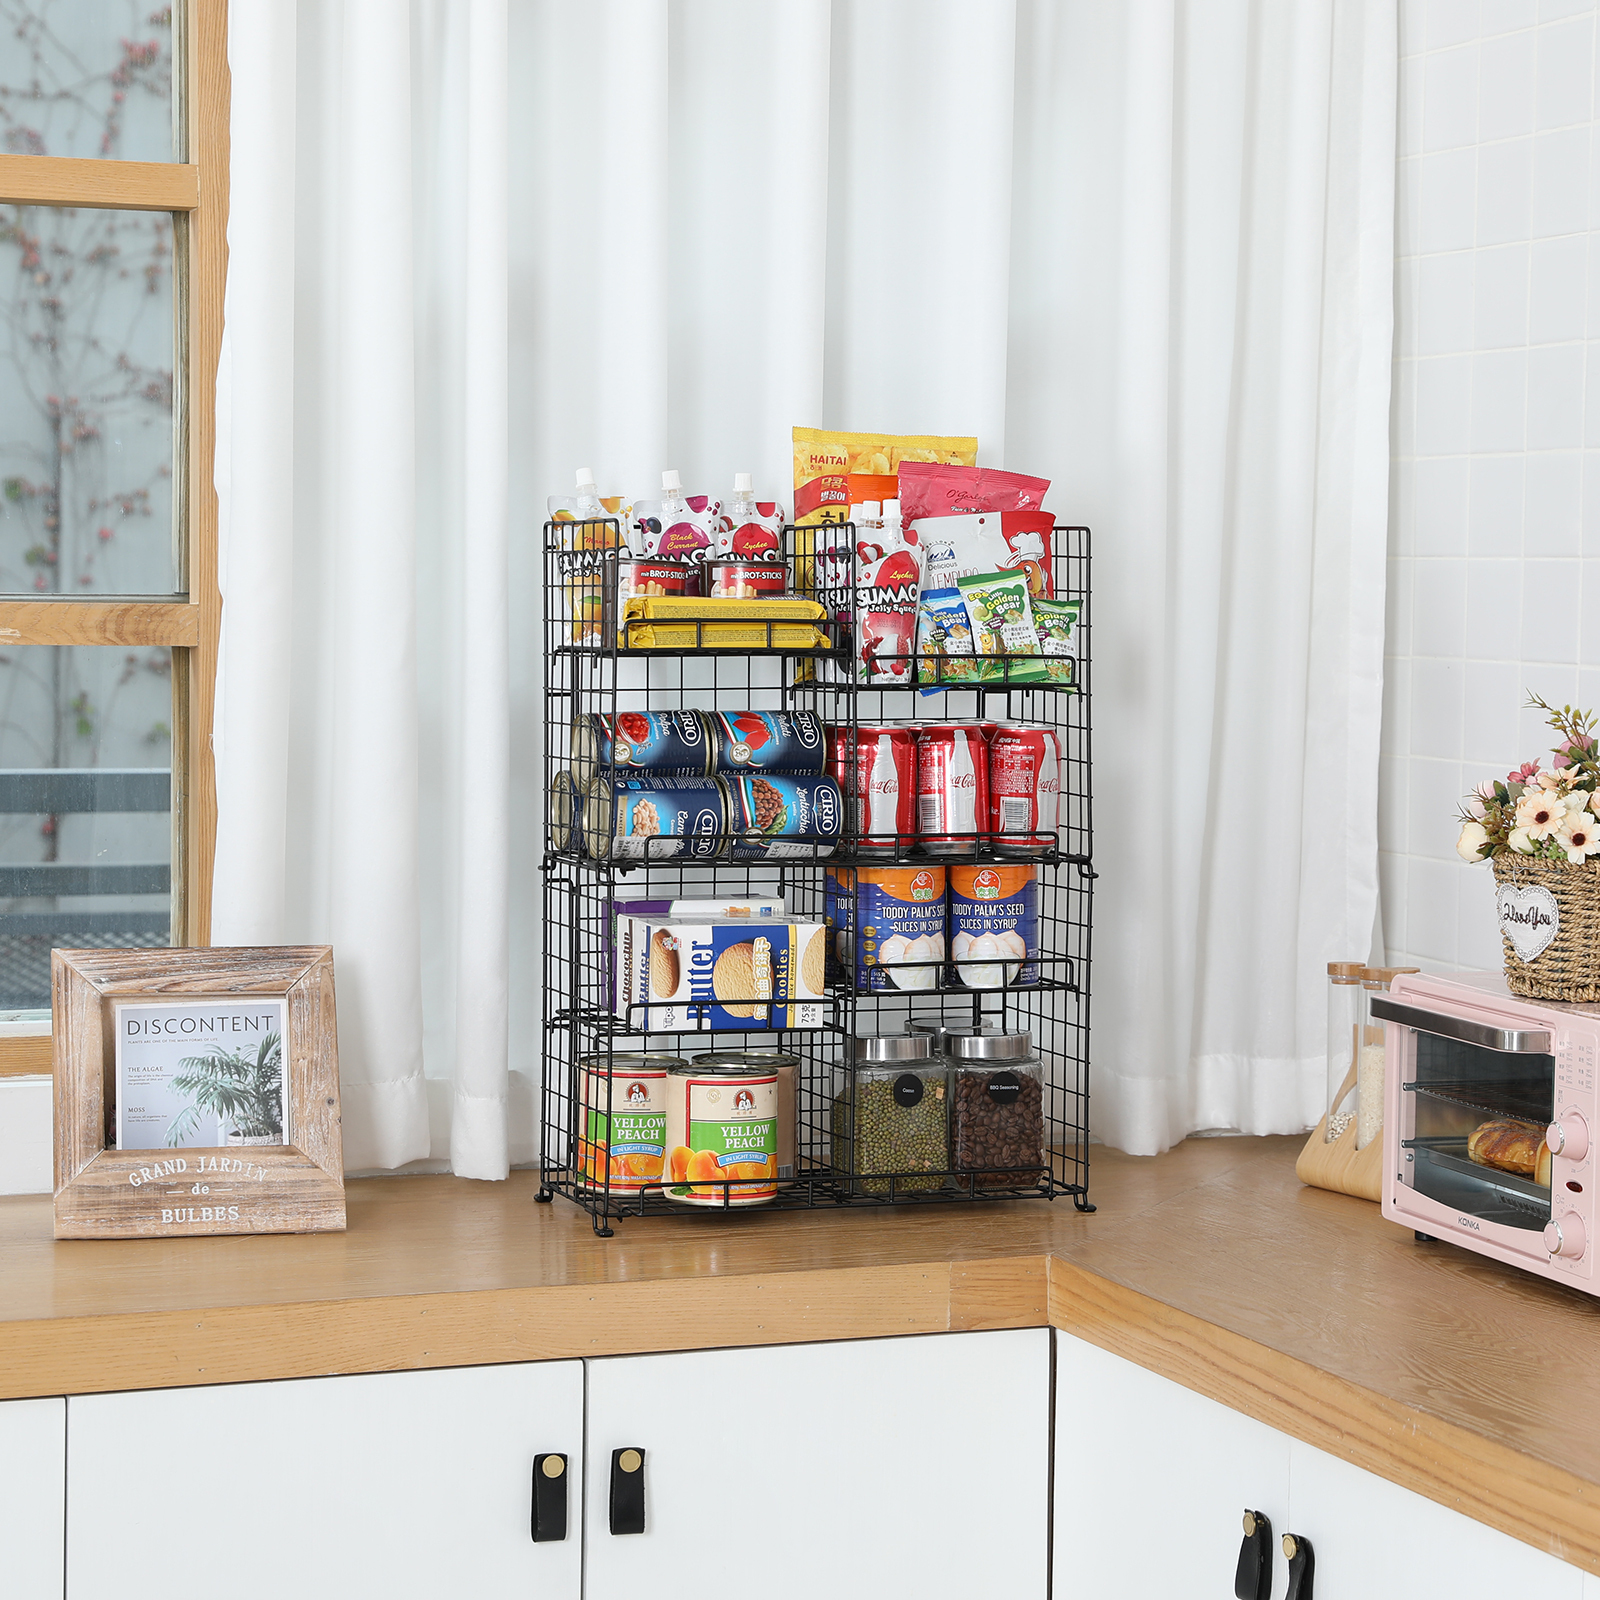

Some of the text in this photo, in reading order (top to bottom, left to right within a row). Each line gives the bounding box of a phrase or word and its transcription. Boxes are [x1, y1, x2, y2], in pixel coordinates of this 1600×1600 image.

[810, 454, 847, 466] HAITAI
[669, 533, 693, 541] Black
[667, 541, 698, 550] Currant
[743, 541, 768, 550] Lychee
[928, 562, 958, 571] Delicious
[739, 571, 783, 580] BROT-STICKS
[890, 570, 914, 580] Lychee
[986, 594, 1020, 610] Golden
[988, 591, 1003, 601] Little
[869, 604, 892, 613] Jelly
[995, 601, 1021, 615] Bear
[932, 611, 966, 622] Golden
[942, 617, 968, 628] Bear
[1044, 618, 1068, 629] Bear
[777, 713, 792, 738] Pelati
[796, 711, 815, 743] CIRIO
[820, 789, 834, 832] CIRIO
[882, 906, 909, 919] TODDY
[911, 905, 937, 918] PALM'S
[952, 903, 1025, 917] TODDY PALM'S SEED
[893, 919, 943, 933] SLICES IN SYRUP
[960, 918, 1018, 930] SLICES IN SYRUP
[776, 949, 788, 1009] Cookies
[663, 1005, 674, 1028] Tipo
[127, 1014, 274, 1036] DISCONTENT
[613, 1117, 666, 1129] YELLOW
[617, 1129, 660, 1140] PEACH
[721, 1124, 770, 1137] YELLOW
[725, 1136, 765, 1149] PEACH
[128, 1156, 268, 1187] GRAND JARDIN
[191, 1183, 210, 1195] de
[161, 1205, 240, 1223] BULBES
[1458, 1216, 1480, 1231] KONKA
